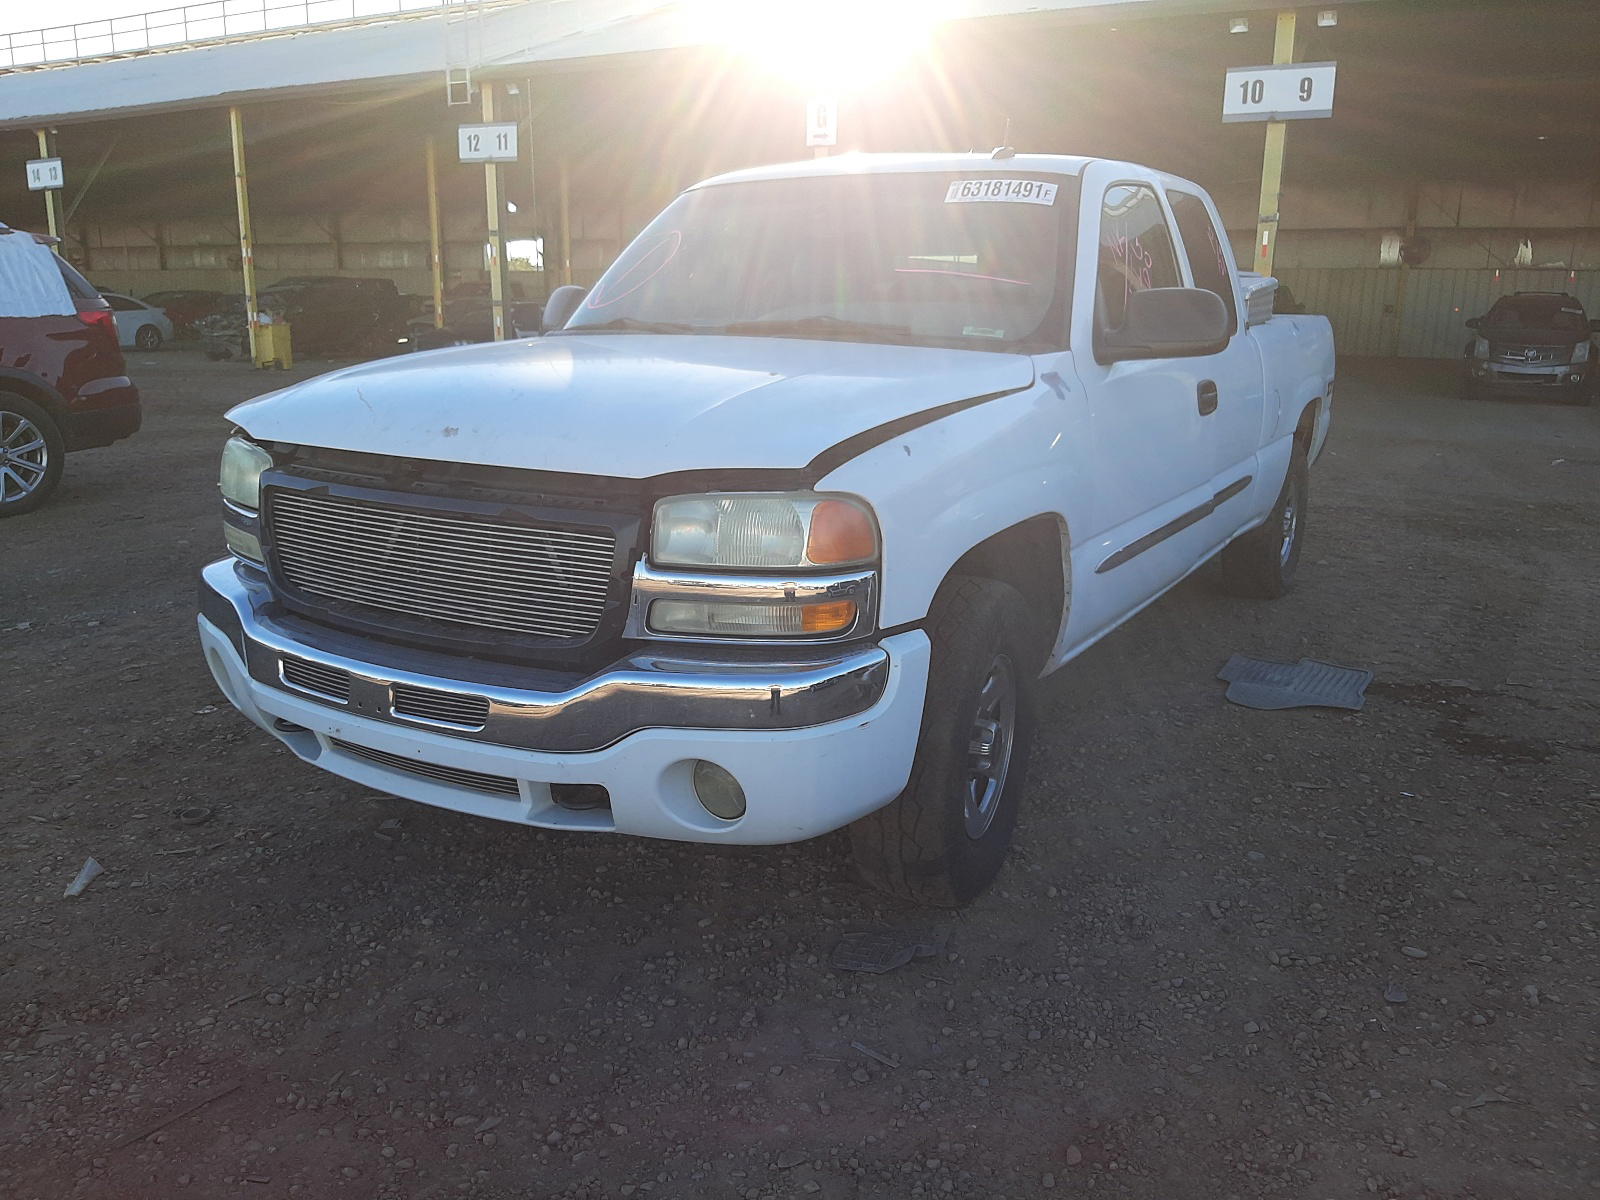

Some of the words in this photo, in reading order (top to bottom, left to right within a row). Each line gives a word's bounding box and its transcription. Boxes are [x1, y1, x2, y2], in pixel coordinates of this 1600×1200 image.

[1240, 80, 1264, 104] 10
[1299, 77, 1312, 102] 9
[467, 134, 480, 152] 12
[496, 133, 508, 151] 11
